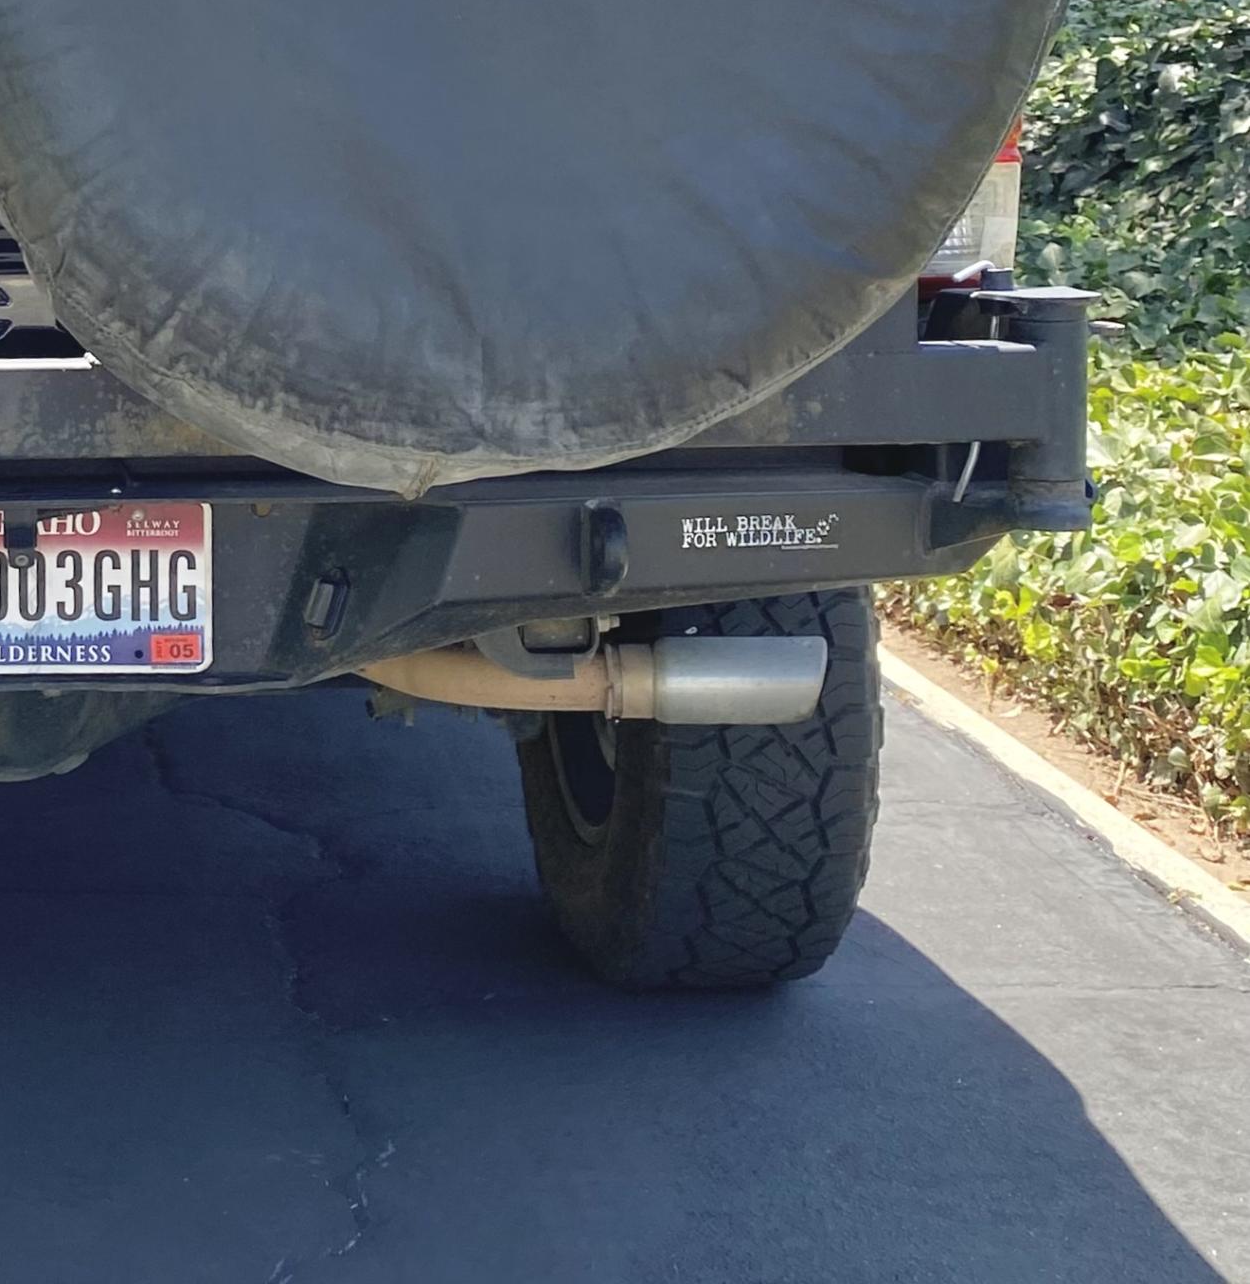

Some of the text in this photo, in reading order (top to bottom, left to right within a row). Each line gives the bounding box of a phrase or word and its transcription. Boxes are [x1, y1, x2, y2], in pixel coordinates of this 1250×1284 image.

[126, 520, 180, 528] SELWAY
[682, 515, 797, 534] WILL BREAK
[126, 529, 180, 537] BITTERROOT
[682, 532, 717, 549] FOR
[169, 643, 194, 659] 05
